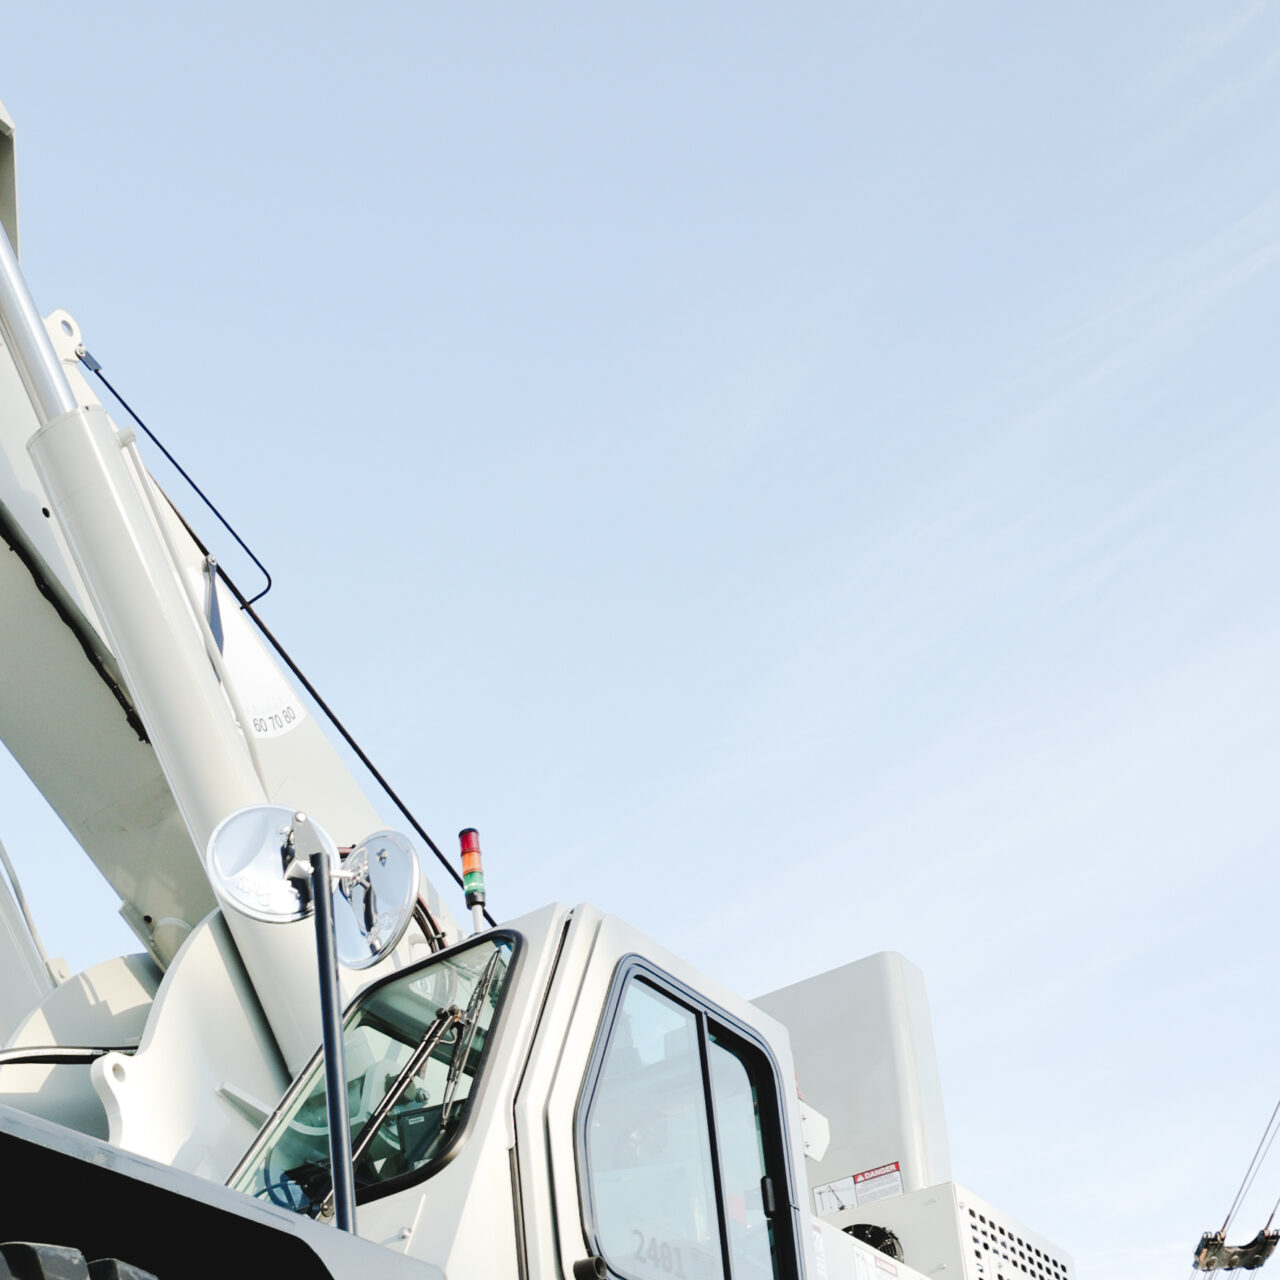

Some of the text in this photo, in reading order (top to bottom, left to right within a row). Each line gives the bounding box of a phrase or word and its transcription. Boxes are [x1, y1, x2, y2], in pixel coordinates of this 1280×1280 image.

[253, 706, 296, 733] 60 70 80
[864, 1164, 896, 1179] DANGER
